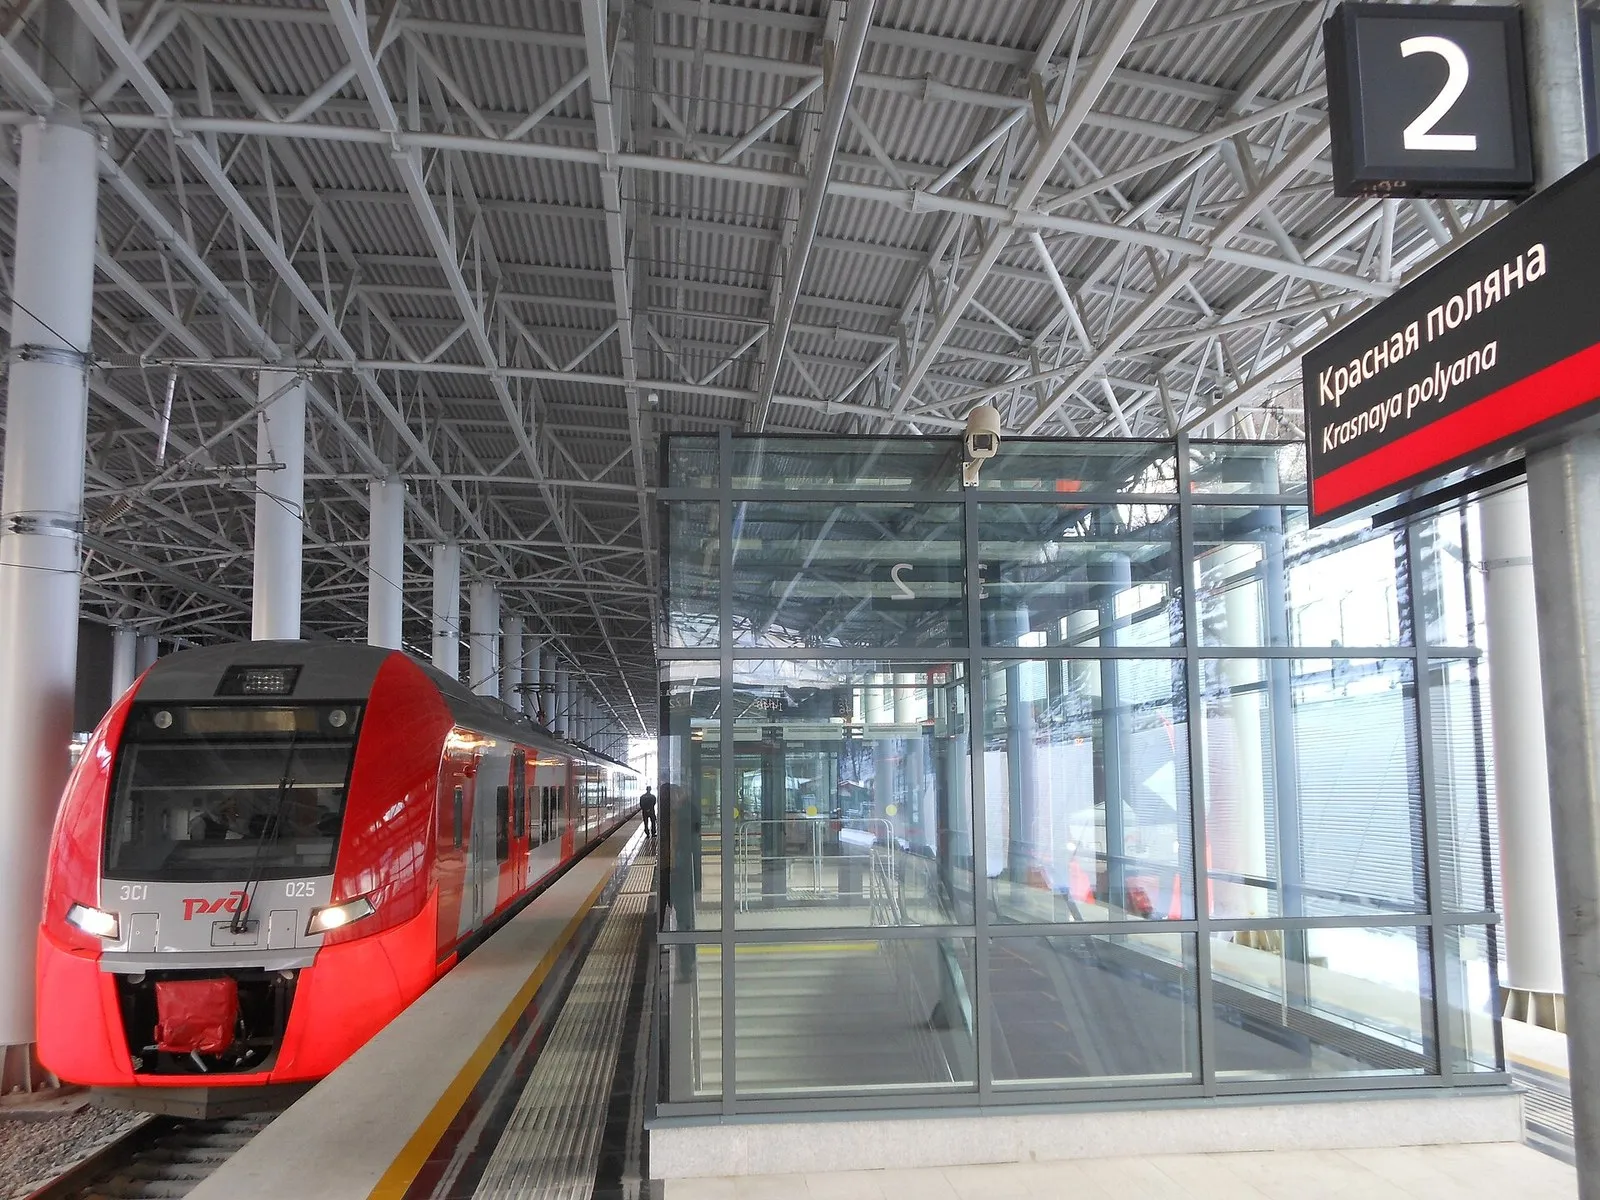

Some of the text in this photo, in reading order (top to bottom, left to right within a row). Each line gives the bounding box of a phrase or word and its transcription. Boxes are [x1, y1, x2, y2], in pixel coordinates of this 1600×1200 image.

[1400, 36, 1478, 151] 2
[1319, 243, 1547, 408] Красная поляна
[1322, 340, 1498, 454] Krasnaya polyana
[285, 882, 316, 897] 025
